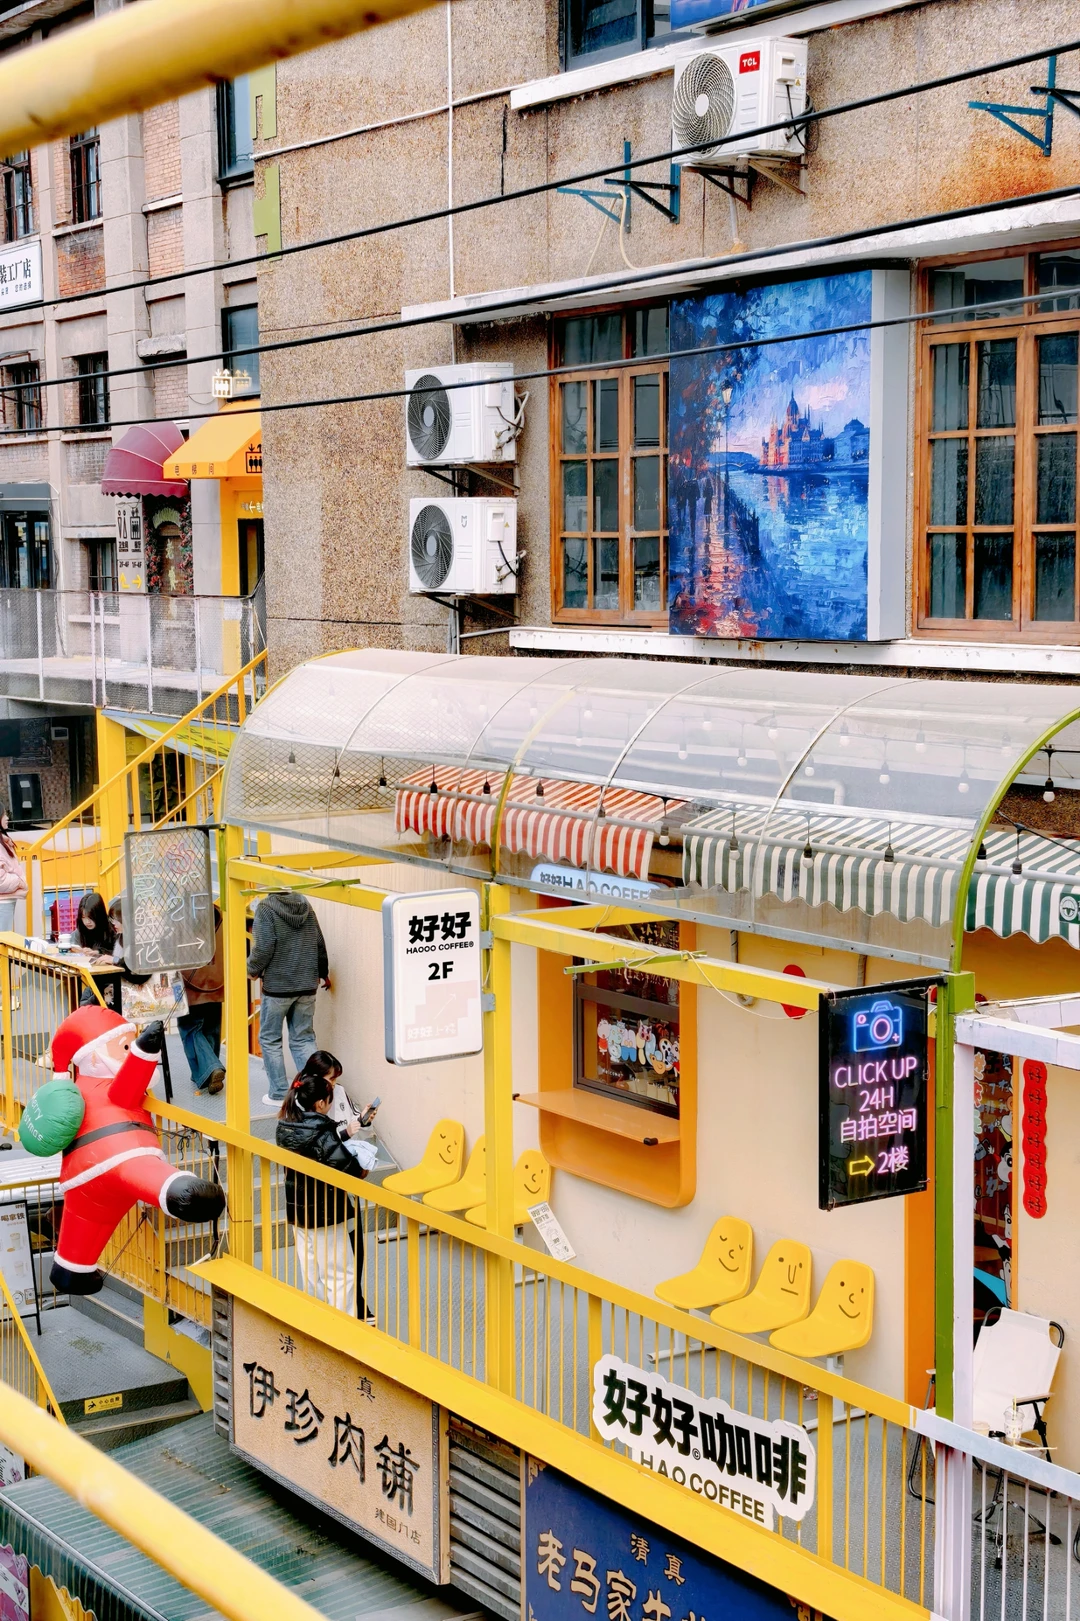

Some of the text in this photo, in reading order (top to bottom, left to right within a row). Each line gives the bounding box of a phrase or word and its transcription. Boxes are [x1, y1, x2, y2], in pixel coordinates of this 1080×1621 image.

[742, 57, 758, 67] TCL
[408, 911, 472, 945] 好好
[406, 944, 437, 955] HAOOO
[428, 961, 454, 981] 2F
[834, 1056, 918, 1089] CLICK UP
[859, 1086, 895, 1112] 24H
[840, 1108, 917, 1144] 自拍空间
[877, 1145, 909, 1174] 2楼
[242, 1361, 420, 1516] 伊珍肉铺
[603, 1368, 808, 1505] 好好咖啡
[640, 1450, 766, 1524] HAO COFFEE
[374, 1506, 422, 1546] 建国门店
[630, 1532, 686, 1586] 清真
